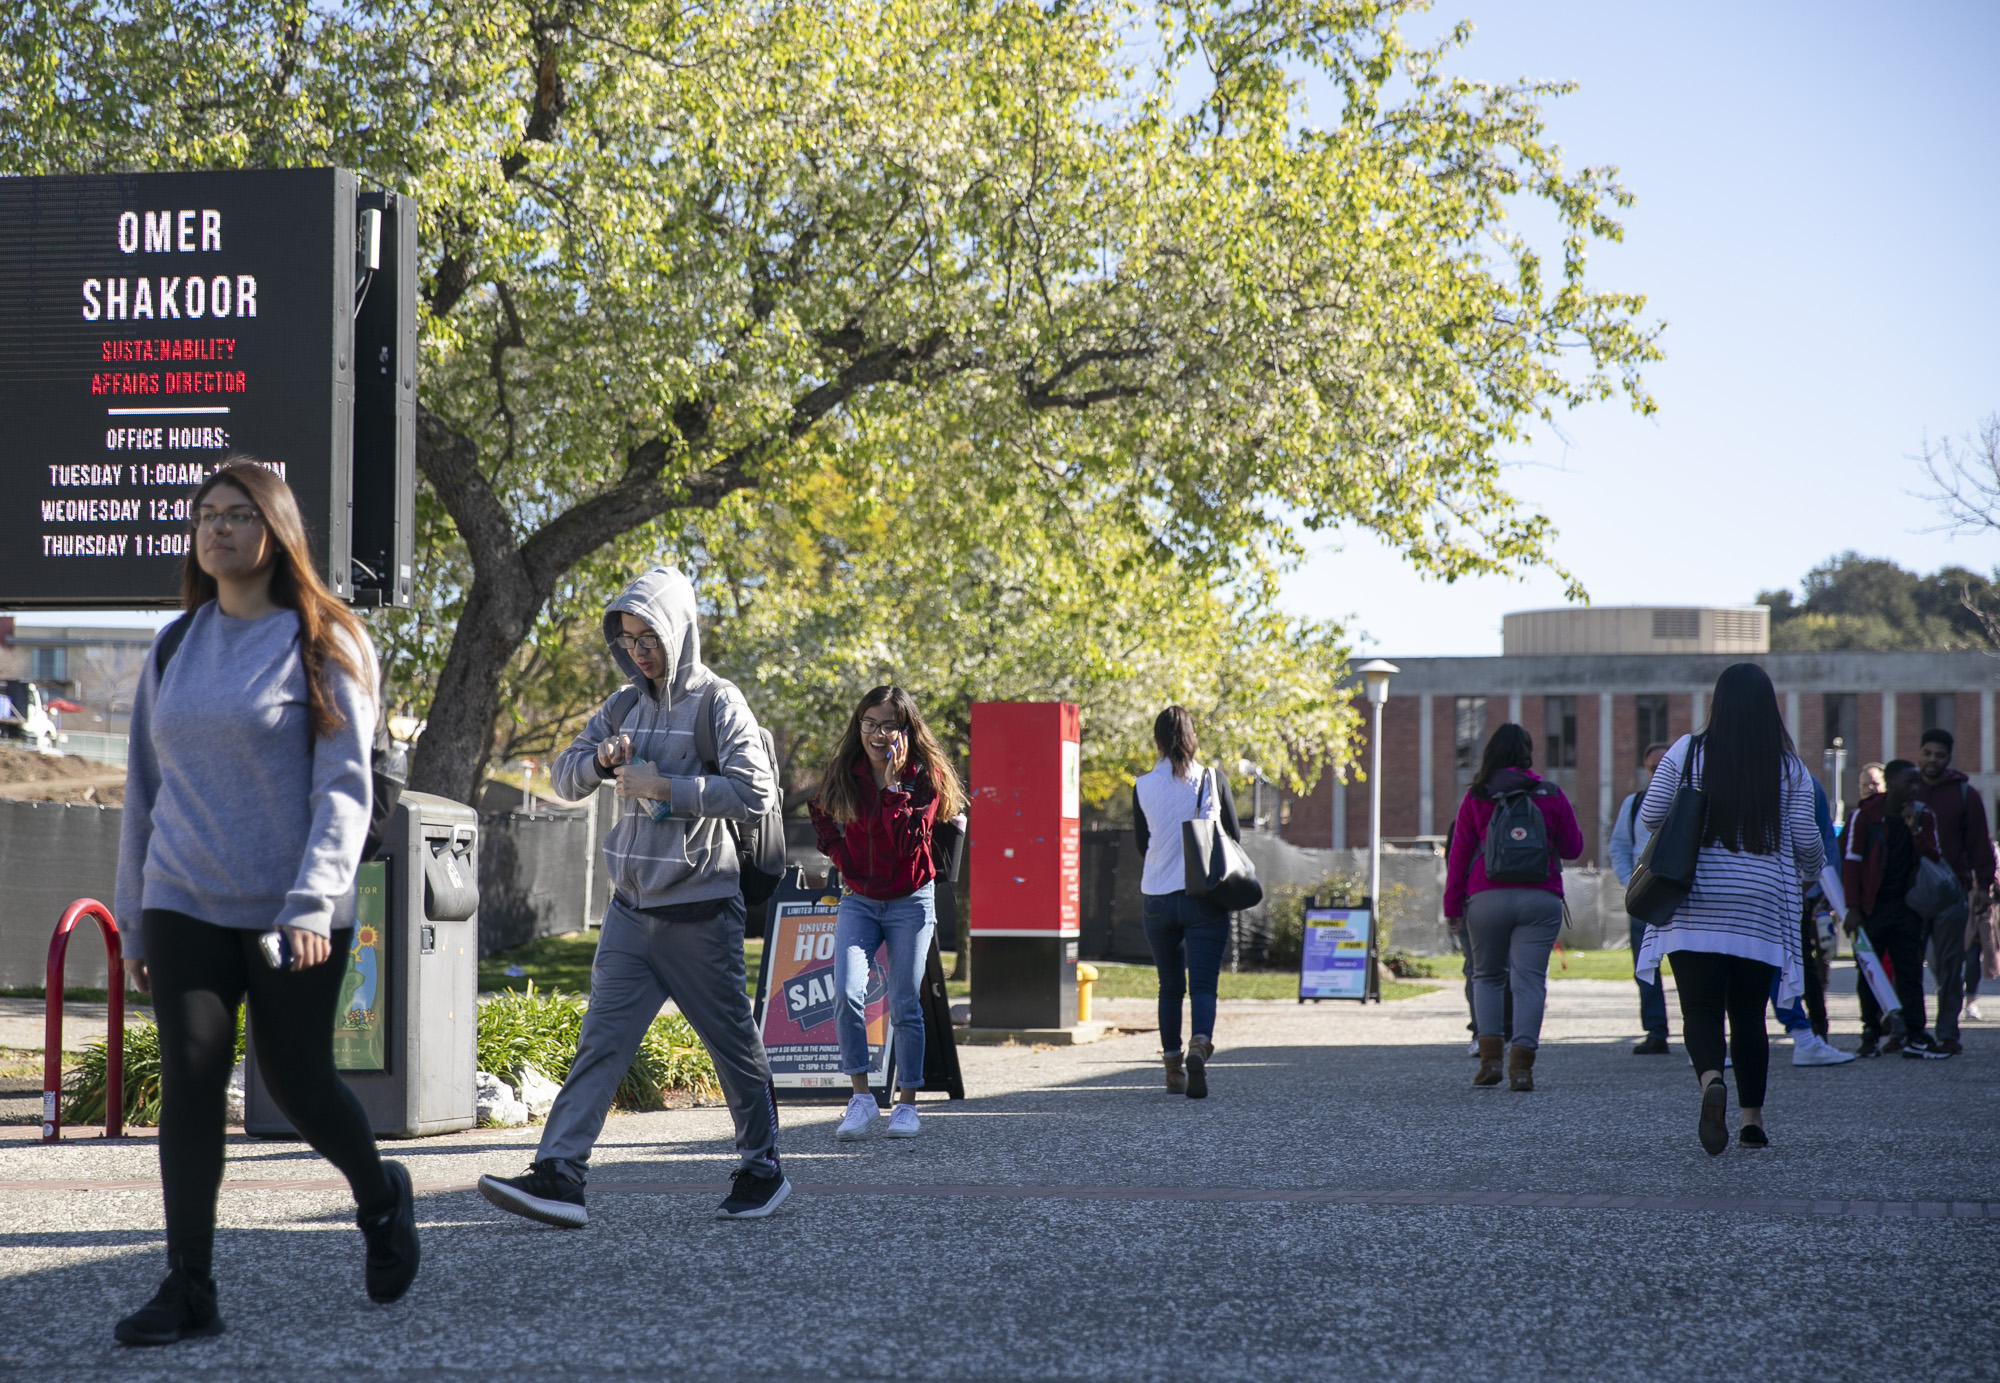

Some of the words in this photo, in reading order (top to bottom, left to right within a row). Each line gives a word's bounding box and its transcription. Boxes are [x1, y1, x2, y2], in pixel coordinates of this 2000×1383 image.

[118, 208, 222, 254] OMER
[82, 274, 257, 321] SHAKOOR
[101, 338, 236, 362] SUSTAINABILITY
[91, 372, 159, 395] AFFAIRS
[165, 370, 246, 394] DIRECTOR
[106, 428, 163, 450] OFFICE
[168, 427, 231, 450] HOURS:
[49, 463, 123, 486] TUESDAY
[42, 535, 129, 557] THURSDAY
[787, 906, 812, 915] LIMITED
[813, 906, 829, 914] TIME
[793, 933, 835, 961] HO
